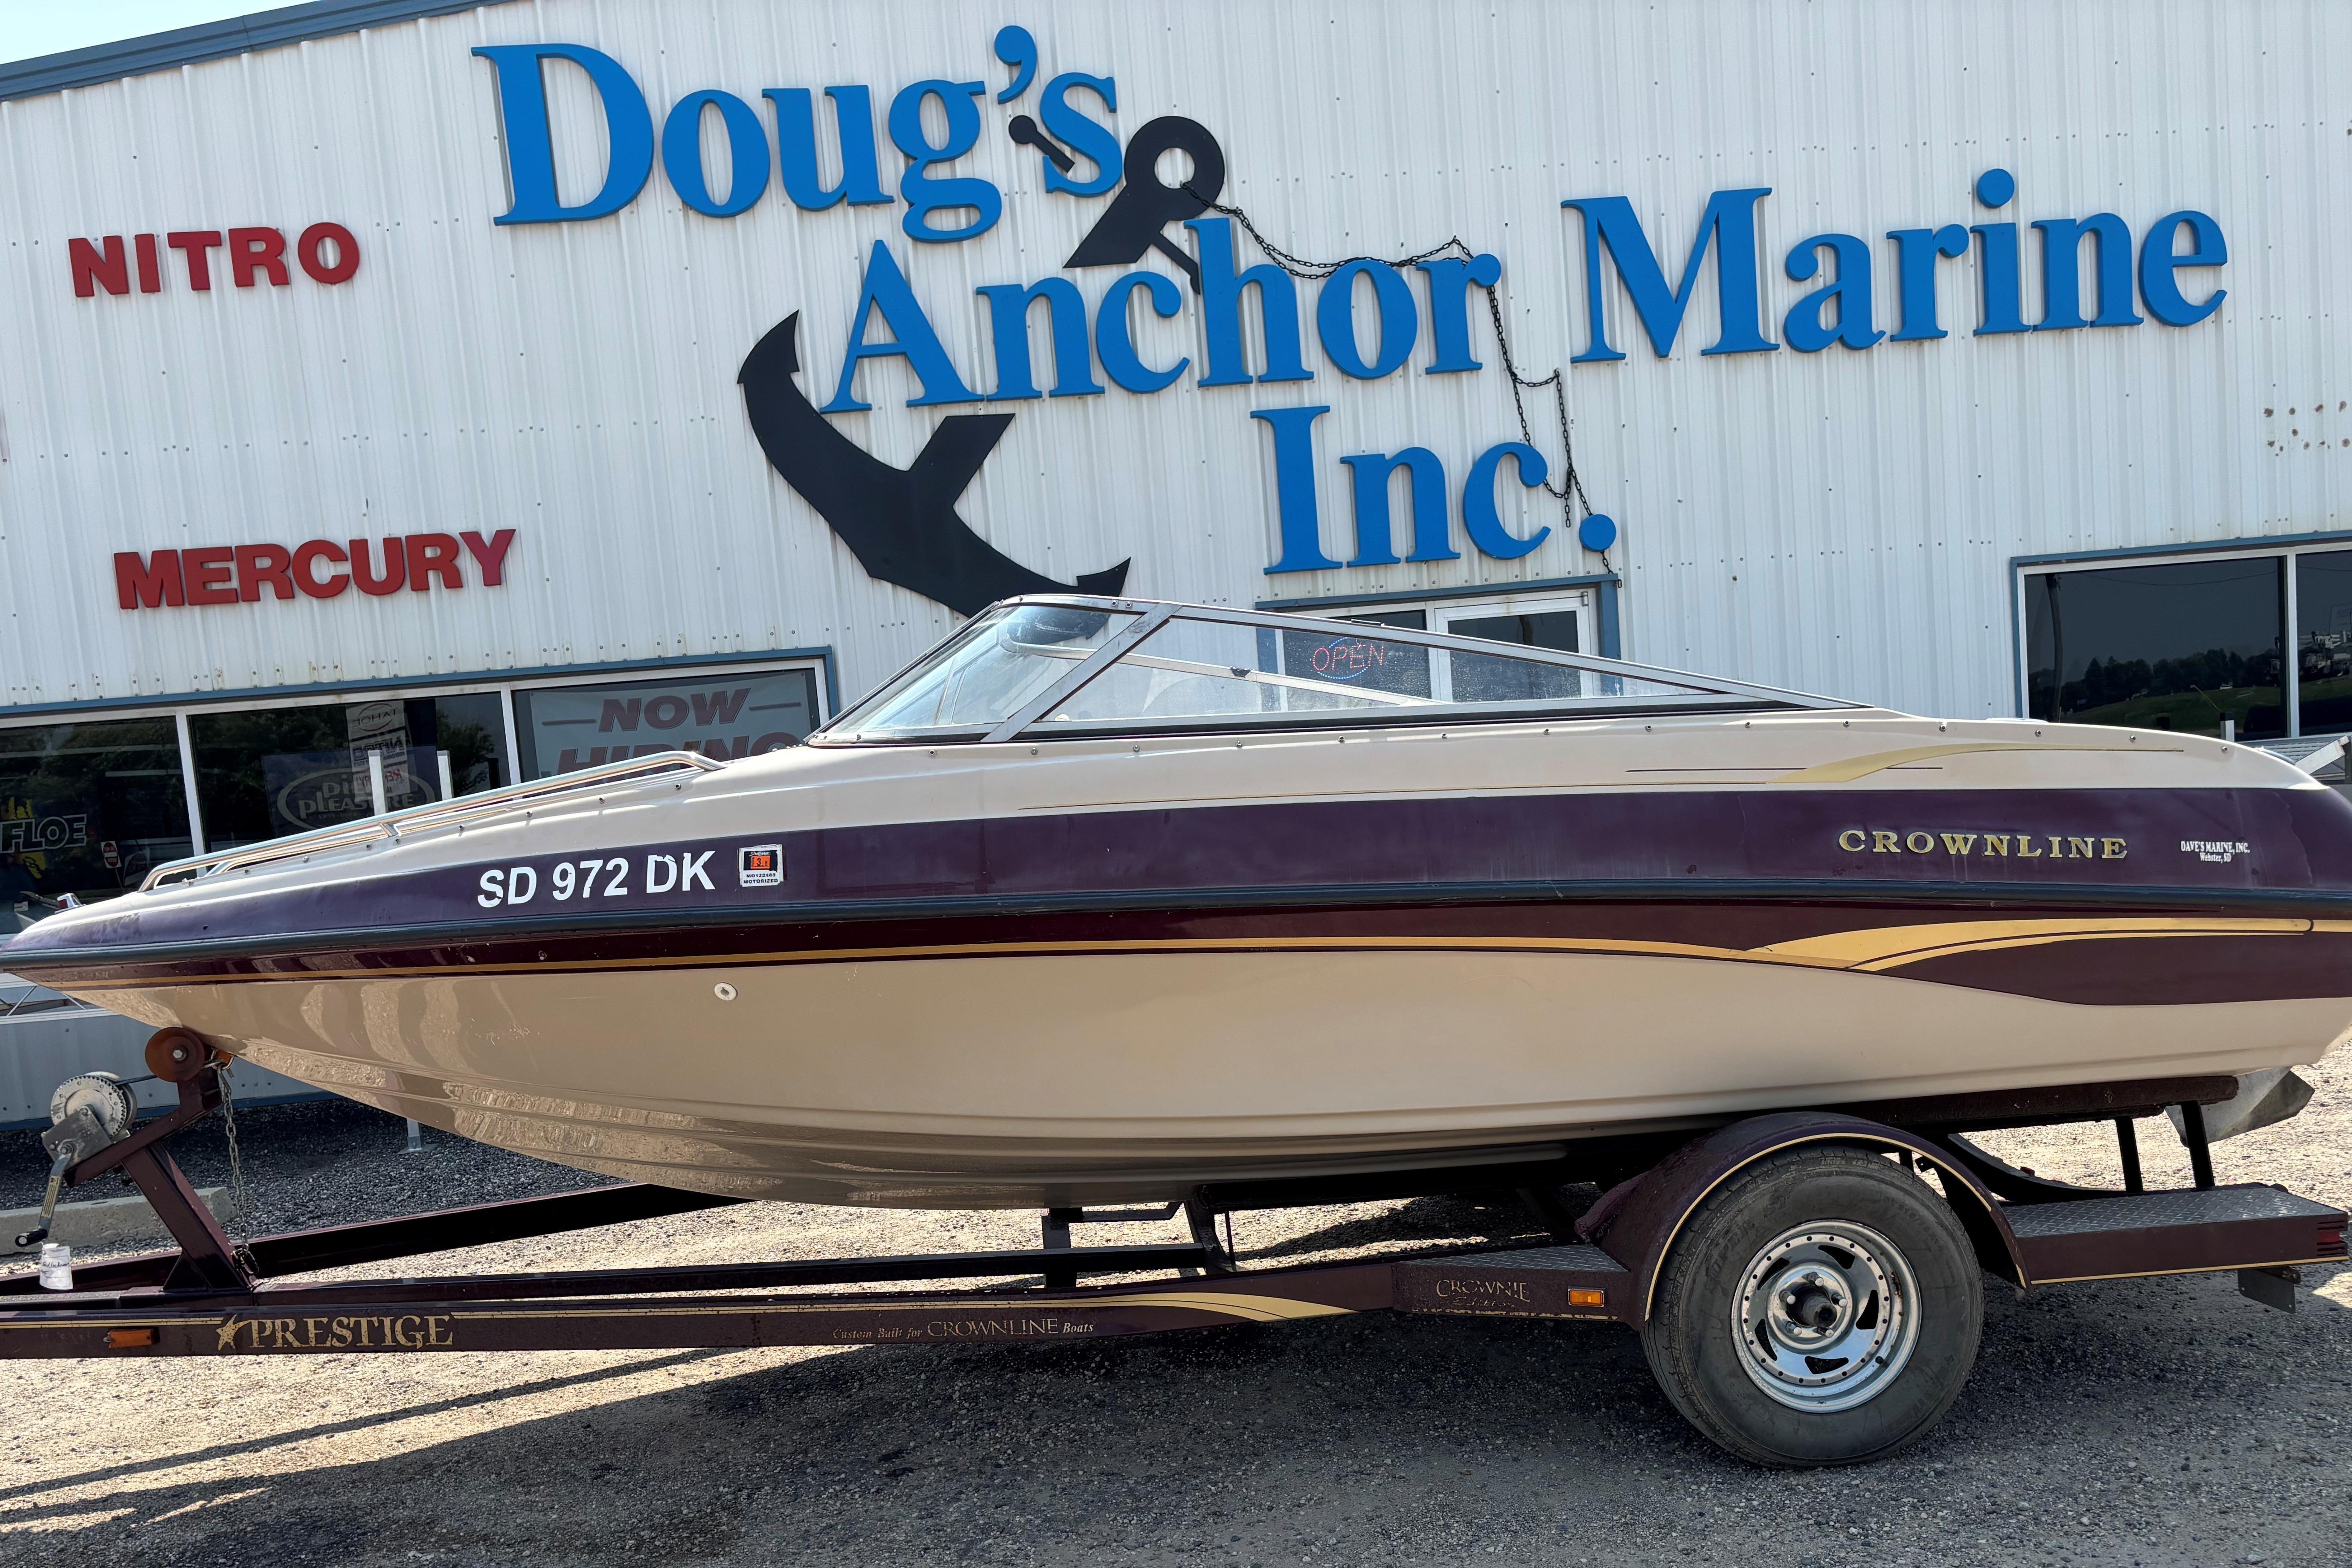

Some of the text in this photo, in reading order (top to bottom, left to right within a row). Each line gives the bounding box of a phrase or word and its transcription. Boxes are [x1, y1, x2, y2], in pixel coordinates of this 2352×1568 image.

[472, 26, 1123, 241] Doug's
[69, 223, 359, 297] NITRO
[820, 169, 2227, 412] Anchor Marine
[1251, 406, 1616, 573] Inc.
[114, 530, 514, 609] MERCURY
[1313, 644, 1384, 671] OPEN
[599, 688, 751, 733] NOW
[0, 814, 87, 853] FLOE
[1839, 830, 2128, 859] CROWNLINE
[2181, 841, 2250, 855] DAVE'S MARINE, INC.
[477, 850, 716, 908] SD 972 DK
[2200, 852, 2232, 864] Webster, SD
[249, 1315, 453, 1349] PRESTIGE
[833, 1318, 1094, 1339] Custom Built for CROWNLINE Boats
